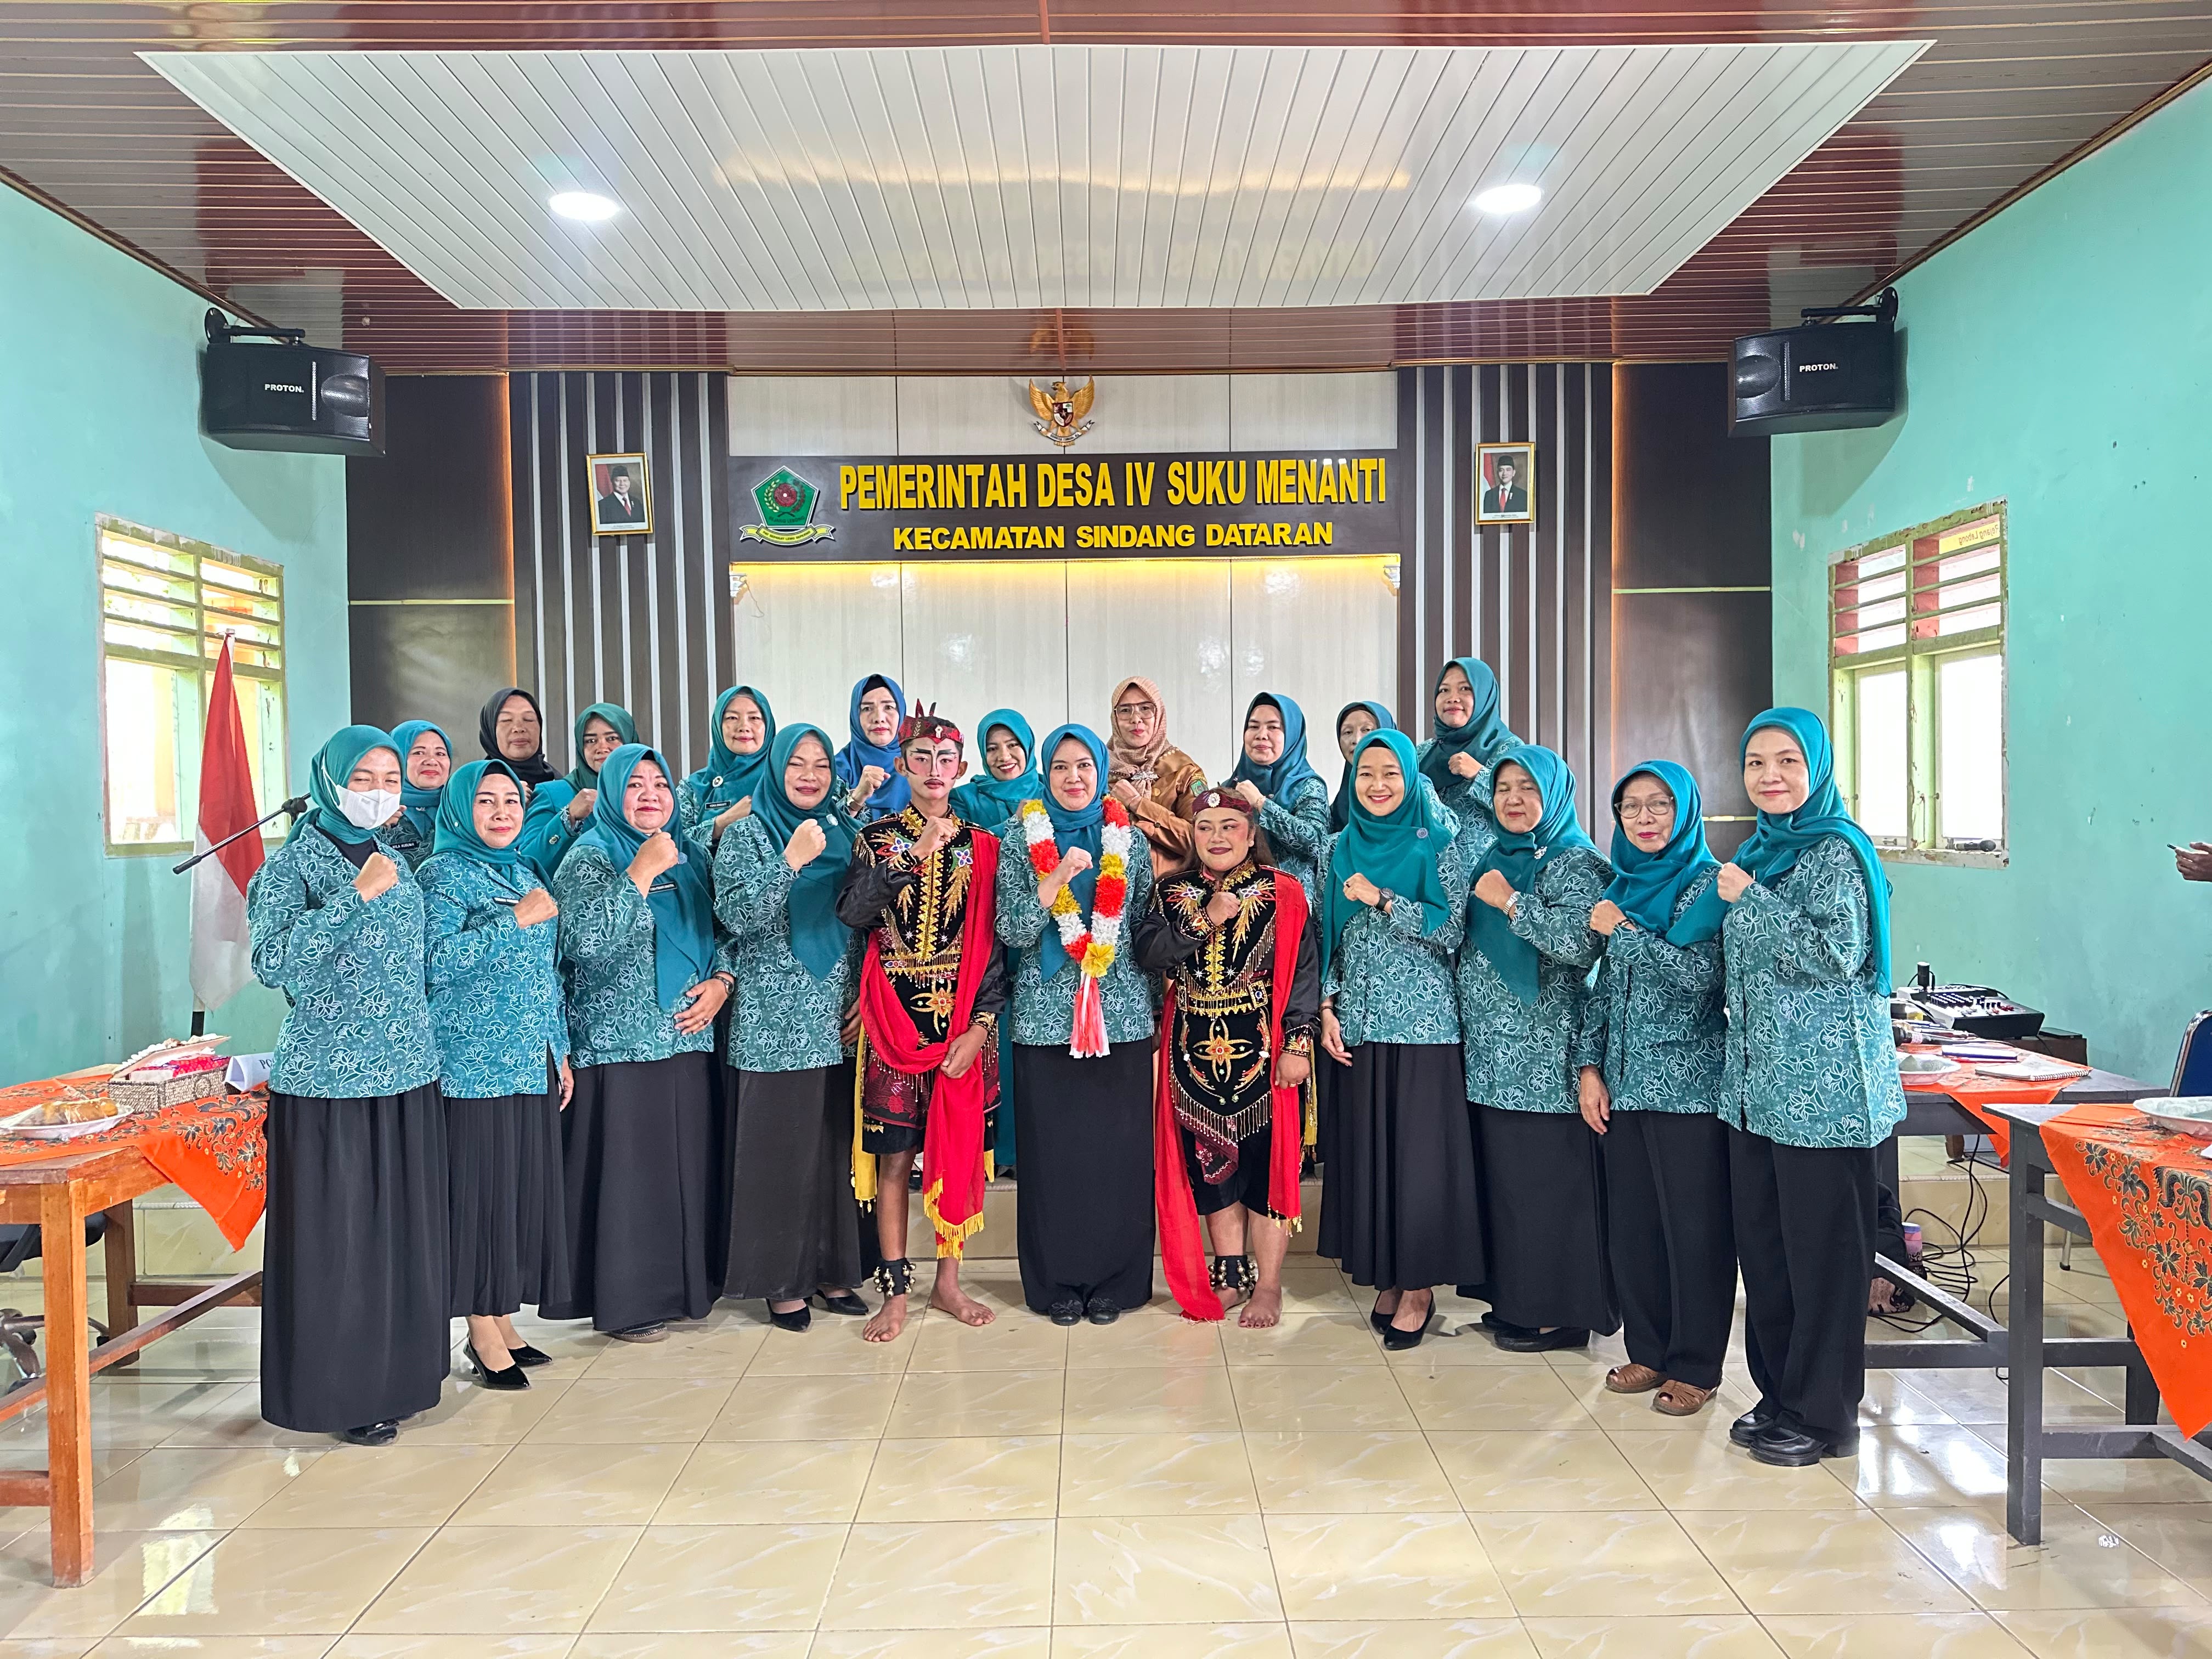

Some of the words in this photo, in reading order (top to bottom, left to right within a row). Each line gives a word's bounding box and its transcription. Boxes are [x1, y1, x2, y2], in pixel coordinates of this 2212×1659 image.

[840, 464, 1027, 510] PEMERINTAH
[1037, 463, 1115, 508] DESA
[1126, 462, 1155, 506] IV
[1167, 461, 1246, 505] SUKU
[1257, 458, 1386, 504] MENANTI
[894, 527, 1065, 550] KECAMATAN
[1077, 524, 1195, 548] SINDANG
[1206, 523, 1333, 546] DATARAN
